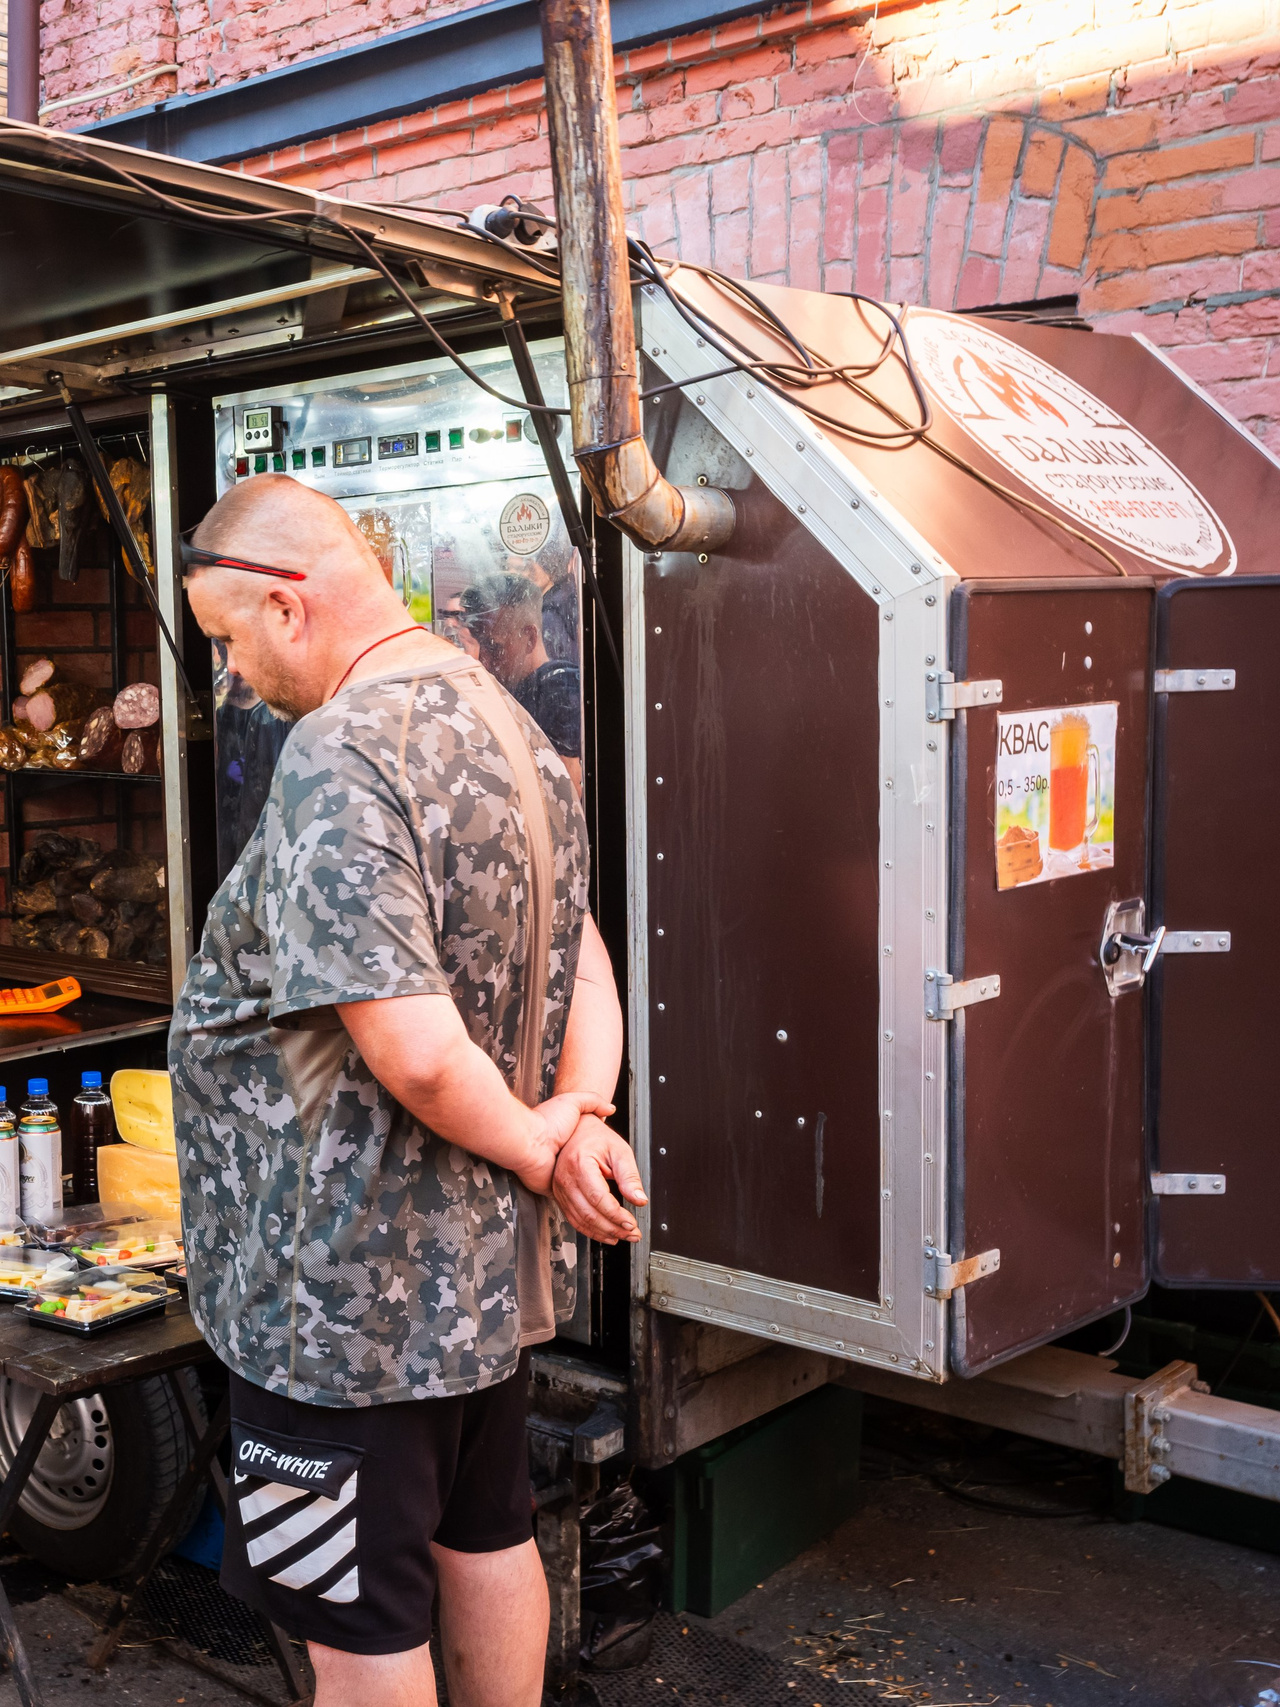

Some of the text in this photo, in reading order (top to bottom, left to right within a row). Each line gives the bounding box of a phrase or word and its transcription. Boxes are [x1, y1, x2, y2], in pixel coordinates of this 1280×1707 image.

[938, 328, 1100, 415] ДЕЛИКАТЕСЫ
[1002, 434, 1149, 467] БАЛЫКИ
[1045, 473, 1174, 494] СТАРОРУССКИЕ
[507, 523, 542, 533] БАЛЫКИ
[999, 721, 1049, 756] КВАС
[998, 779, 1013, 799] 0,5
[239, 1440, 333, 1479] OFF-WHITE
